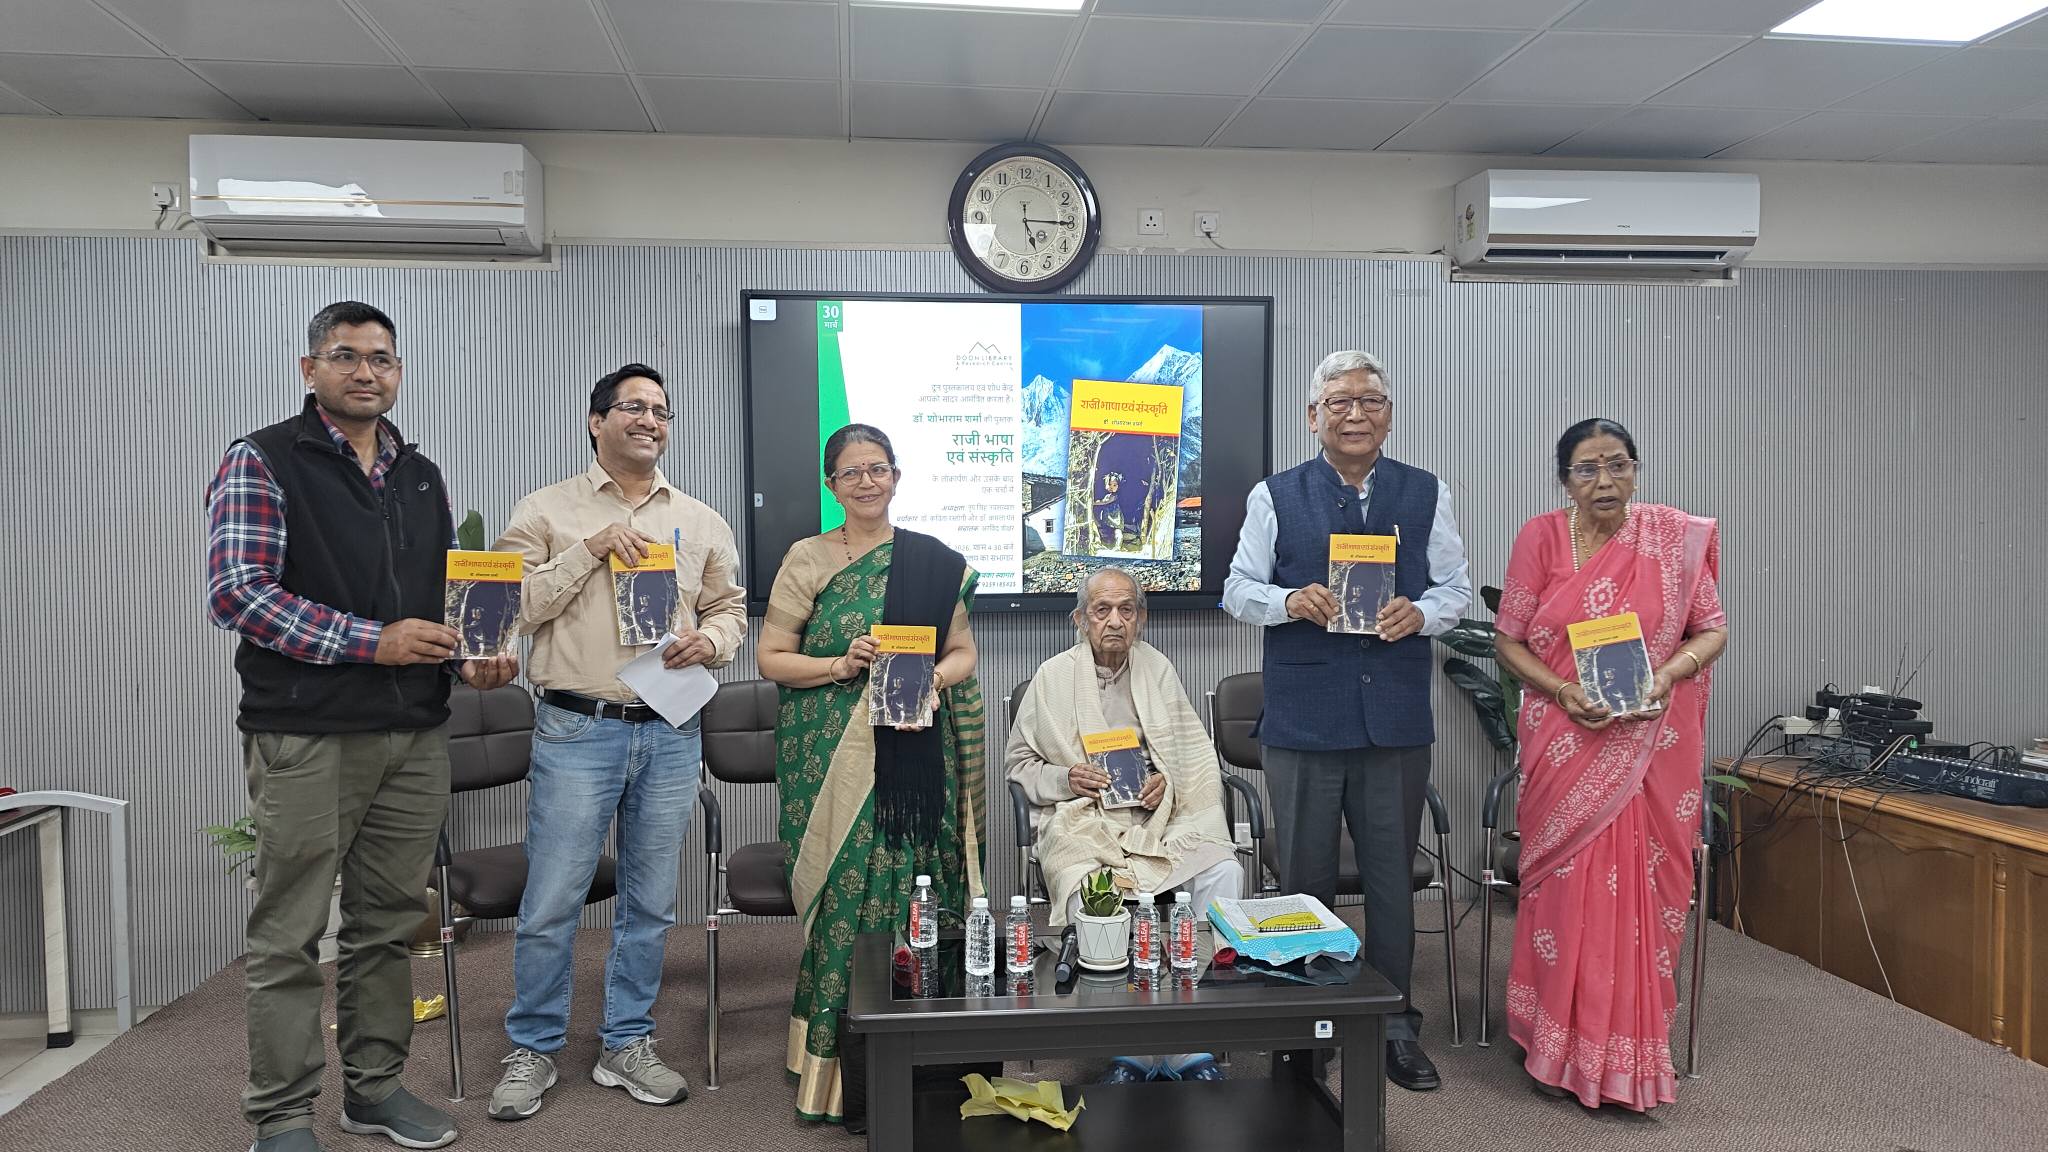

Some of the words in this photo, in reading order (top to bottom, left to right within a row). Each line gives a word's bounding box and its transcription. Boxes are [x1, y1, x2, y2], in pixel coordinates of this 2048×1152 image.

[998, 173, 1007, 185] 11
[1020, 168, 1032, 179] 12
[1046, 174, 1051, 187] 1
[980, 189, 992, 200] 10
[1061, 192, 1070, 205] 2
[974, 211, 984, 224] 9
[1066, 216, 1075, 230] 3
[1059, 239, 1069, 253] 4
[998, 254, 1006, 267] 7
[1042, 256, 1051, 269] 5
[1020, 261, 1029, 274] 6
[822, 305, 839, 319] 30
[824, 320, 838, 329] मार्च
[1080, 397, 1100, 410] राजी
[1100, 401, 1120, 411] भाषा
[1121, 400, 1136, 412] एवं
[1136, 401, 1168, 417] संस्कृति
[927, 412, 963, 423] शोभाराम
[965, 412, 982, 423] शर्मा
[952, 431, 981, 446] राजी
[984, 433, 1014, 446] भाषा
[946, 449, 964, 465] एवं
[968, 448, 1014, 466] संस्कृति
[1018, 926, 1026, 946] CLEAR
